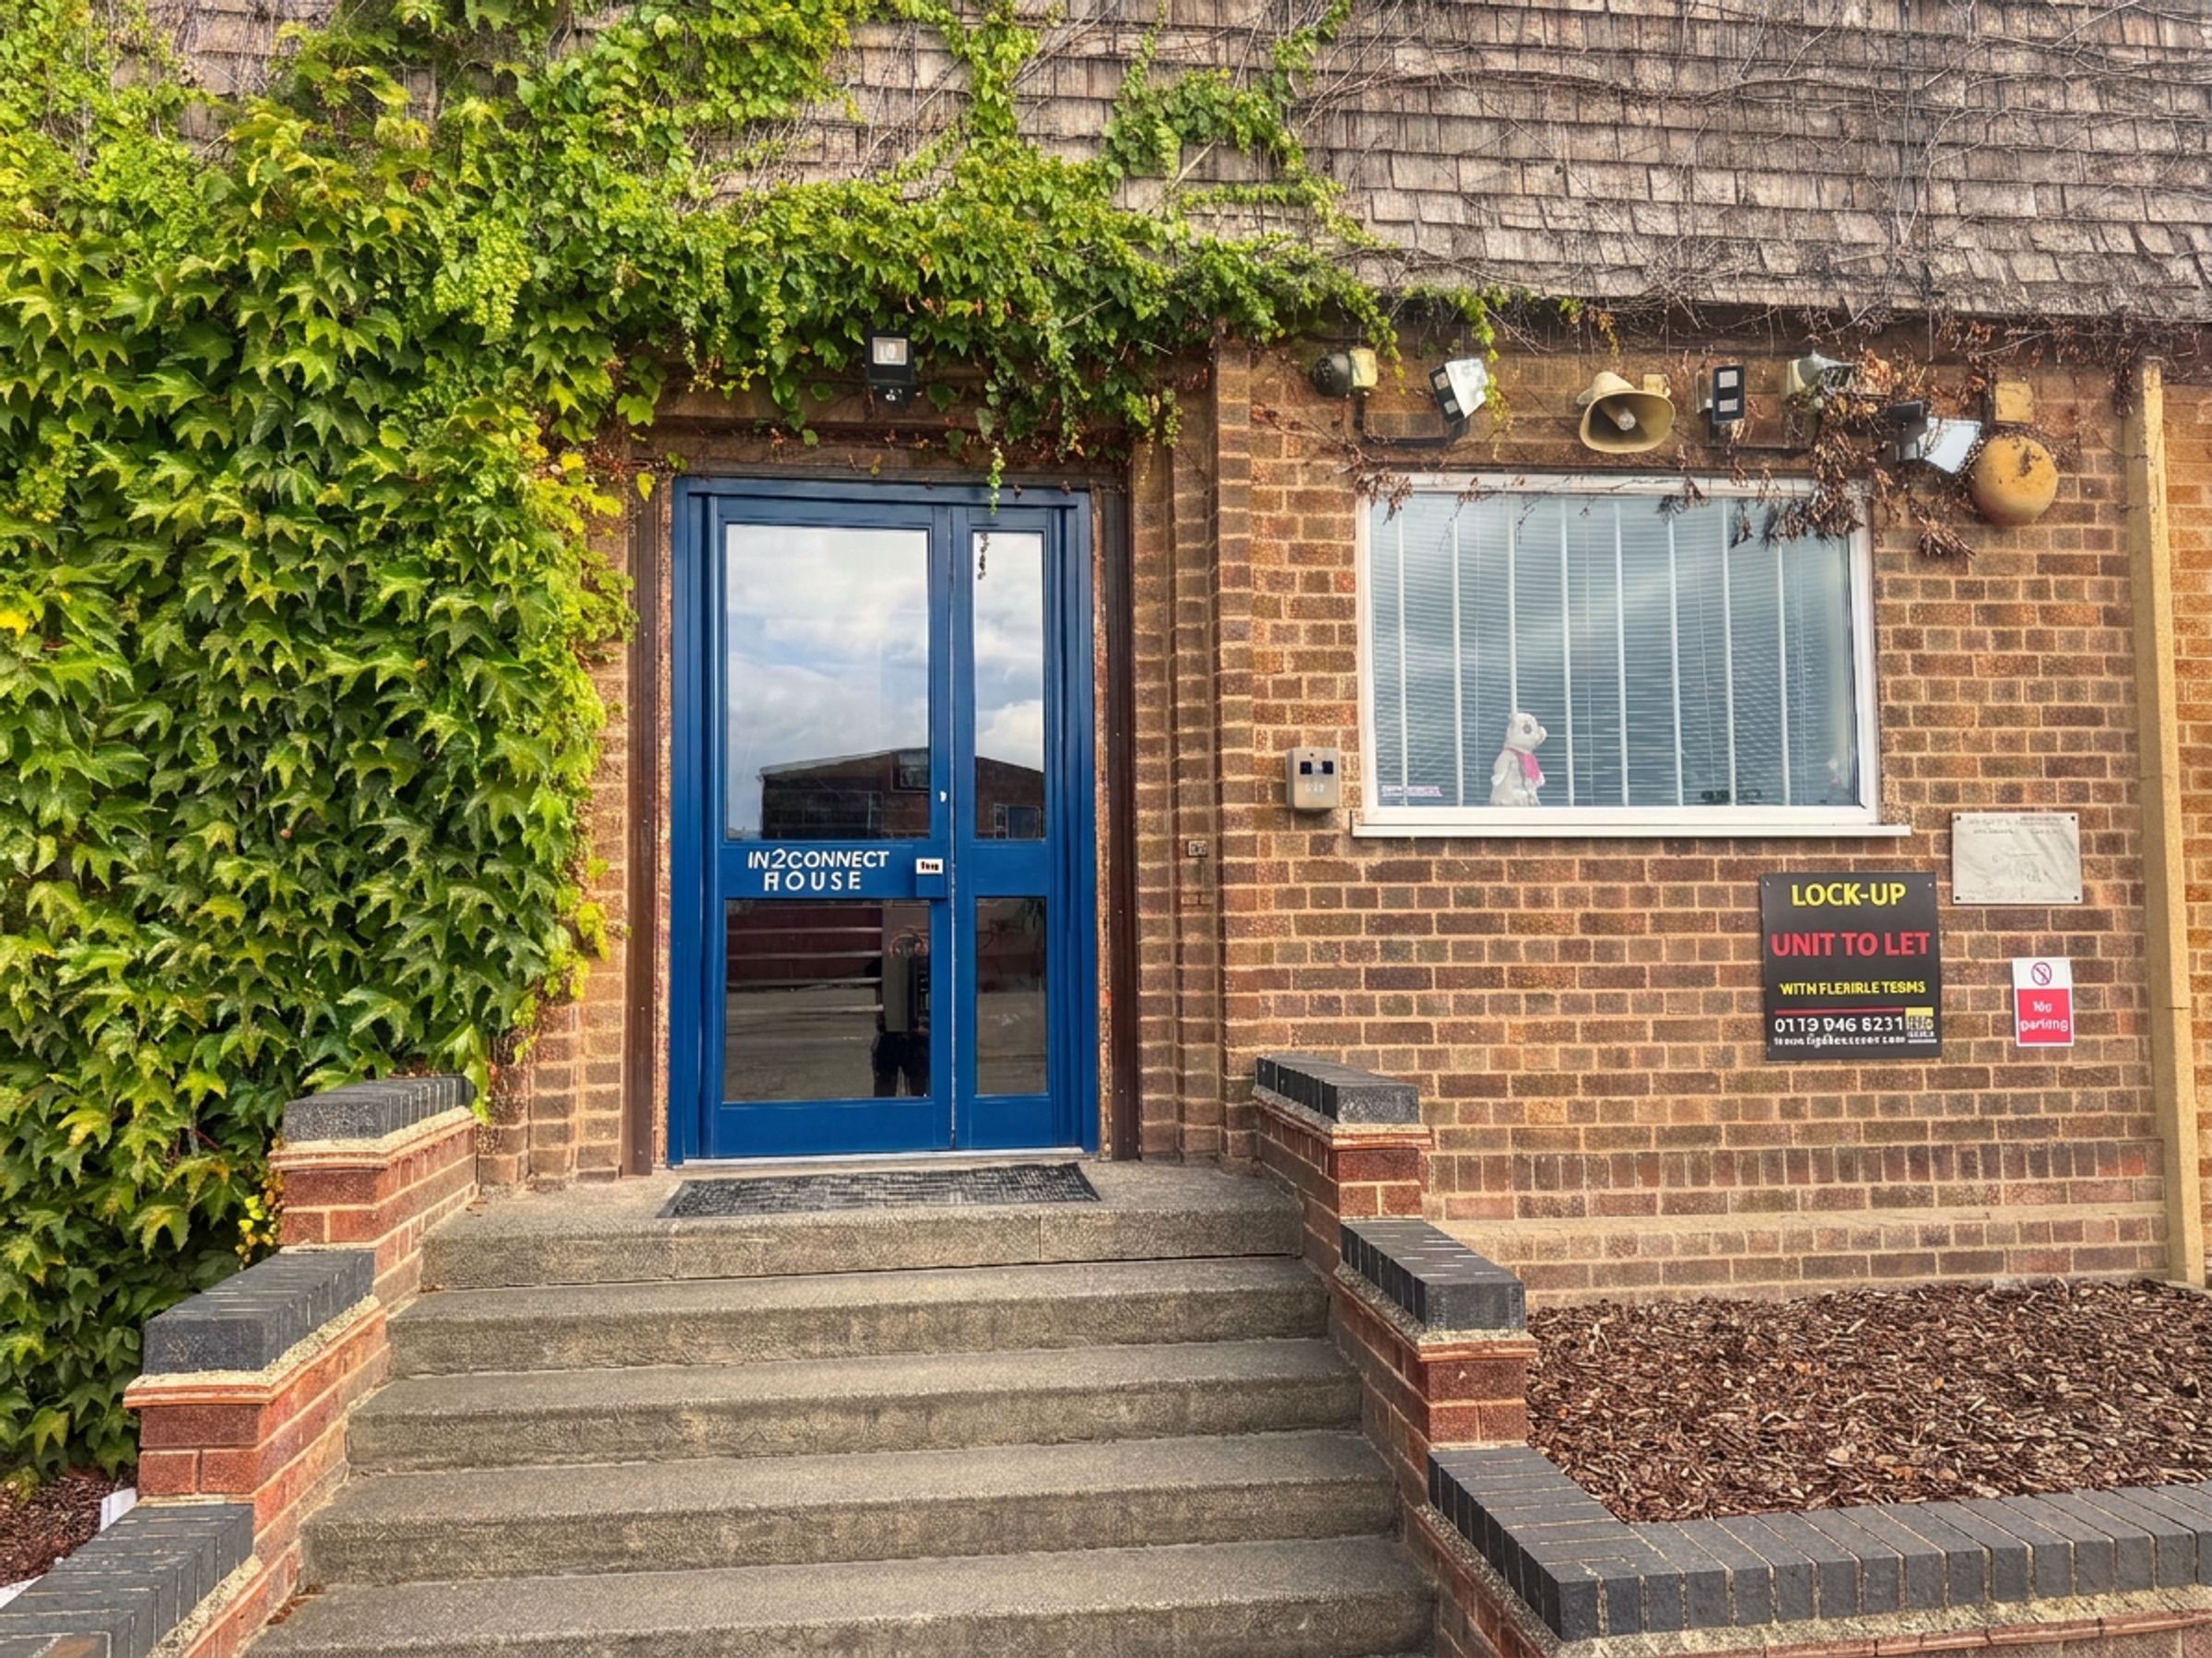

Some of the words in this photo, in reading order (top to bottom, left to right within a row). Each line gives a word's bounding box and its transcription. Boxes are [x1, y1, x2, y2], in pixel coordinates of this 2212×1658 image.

[747, 848, 889, 869] IN2CONNECT
[763, 871, 861, 891] HOUSE
[1791, 882, 1906, 906] LOCK-UP
[1771, 933, 1835, 957] UNIT
[1841, 933, 1877, 957] TO
[1884, 932, 1930, 956] LET
